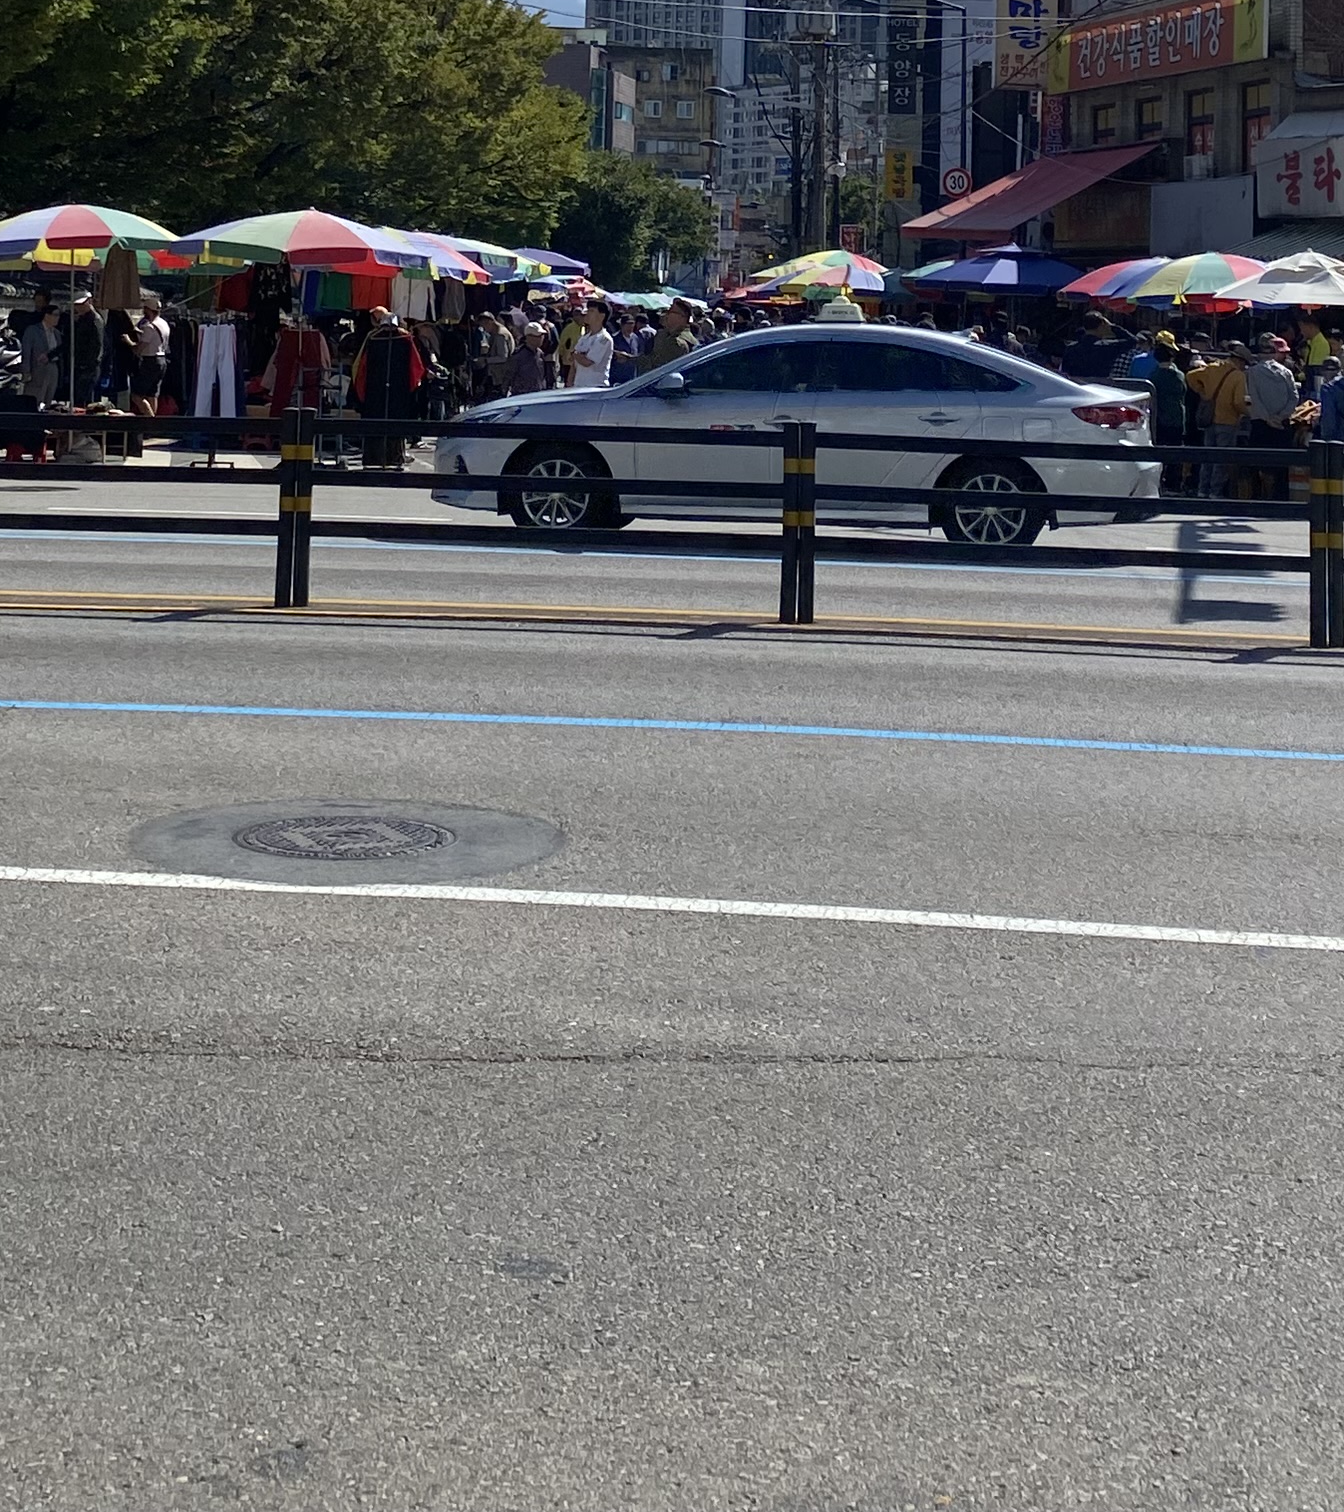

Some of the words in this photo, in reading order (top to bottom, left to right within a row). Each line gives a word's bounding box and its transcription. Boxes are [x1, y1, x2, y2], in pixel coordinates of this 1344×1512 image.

[887, 18, 919, 28] HOTEL
[1077, 1, 1225, 80] 건강식품할인매장
[893, 32, 912, 106] 동양장
[949, 174, 965, 190] 30
